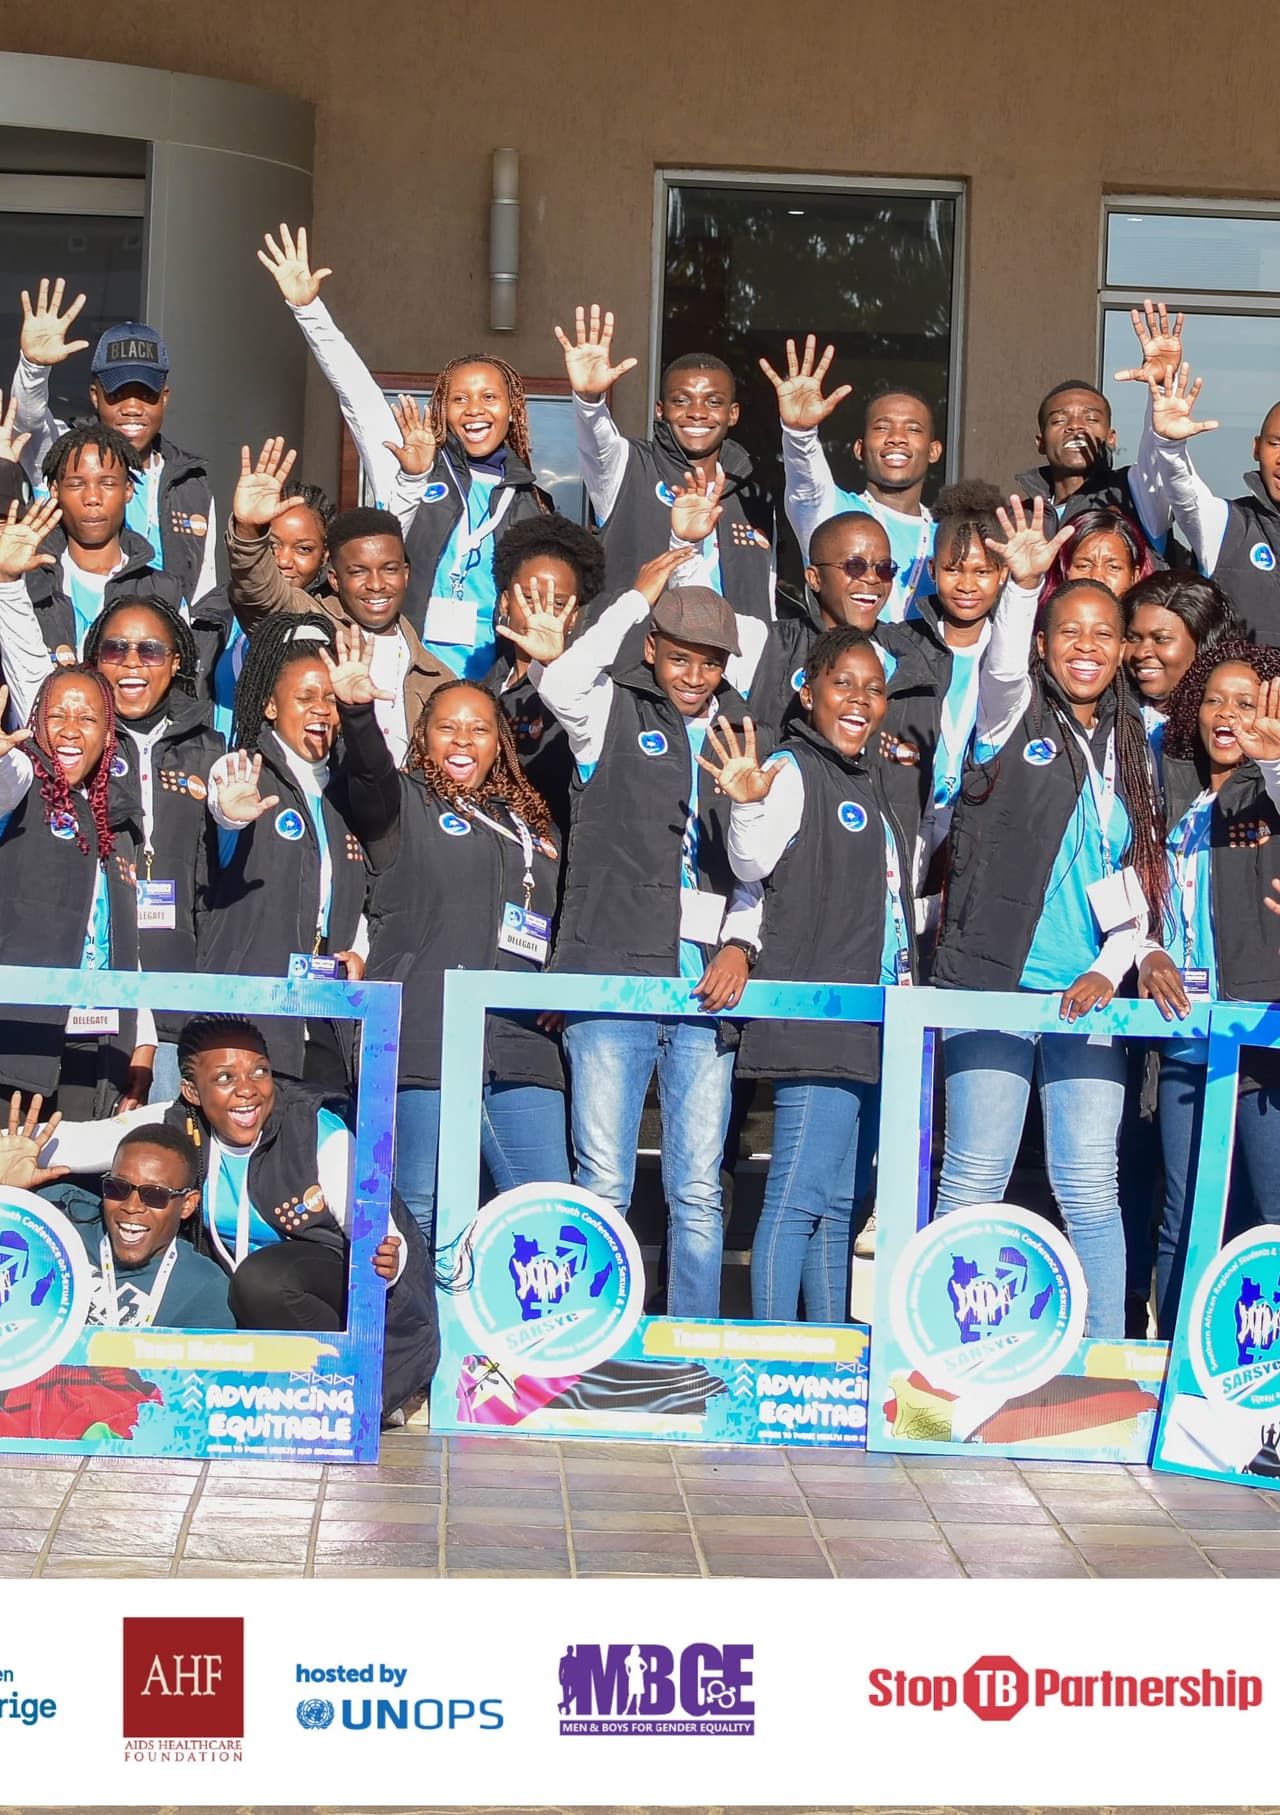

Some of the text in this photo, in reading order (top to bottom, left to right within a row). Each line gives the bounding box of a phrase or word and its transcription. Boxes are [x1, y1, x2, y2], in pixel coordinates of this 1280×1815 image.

[111, 340, 154, 360] BLACK
[139, 911, 165, 921] LEGATE
[506, 934, 538, 952] DELEGATE
[72, 1015, 108, 1025] DELEGATE
[581, 1212, 619, 1252] Conference
